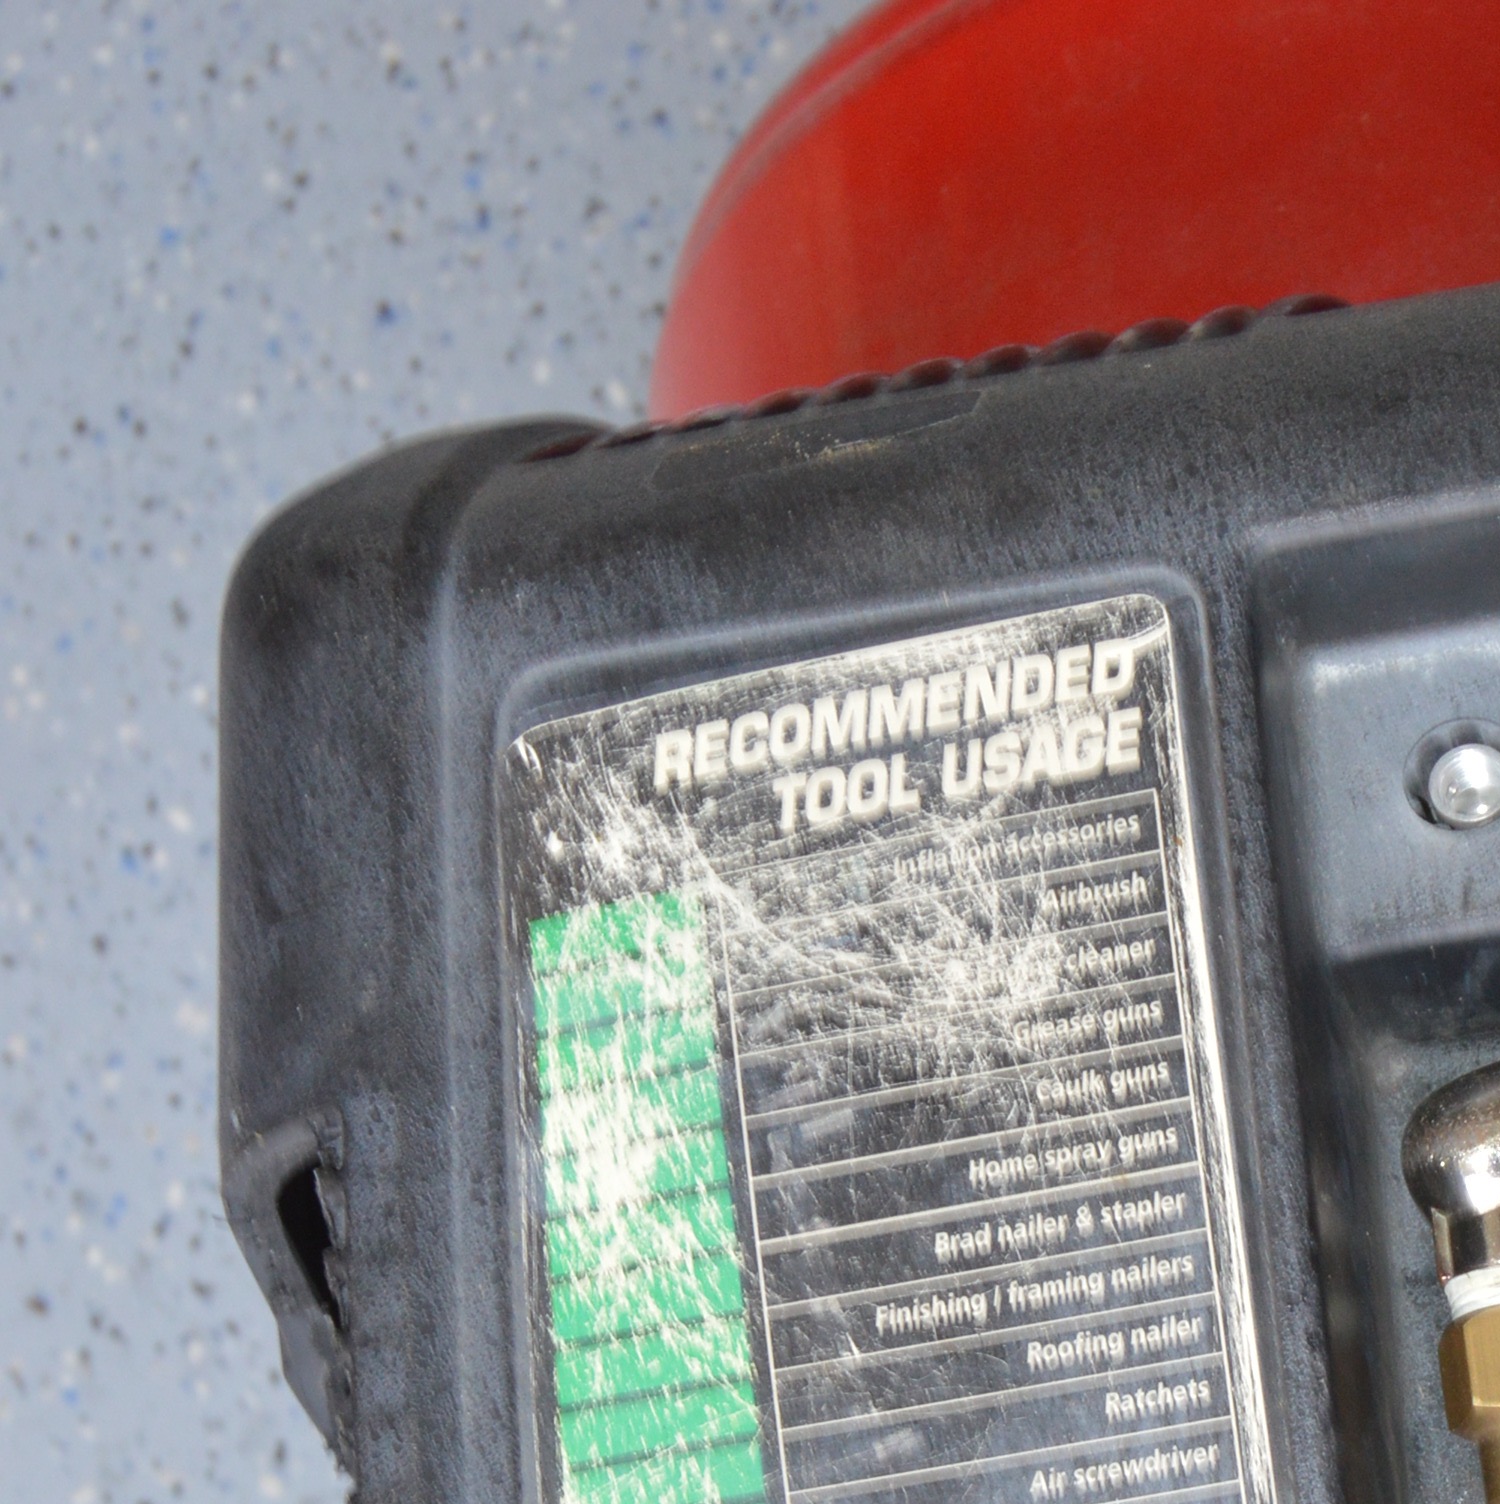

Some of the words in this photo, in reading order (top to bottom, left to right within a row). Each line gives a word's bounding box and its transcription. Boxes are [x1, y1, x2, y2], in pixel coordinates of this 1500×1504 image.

[653, 637, 1135, 796] RECOMMENDED
[772, 754, 922, 834] TOOL
[940, 706, 1143, 798] USAGE
[1042, 871, 1148, 912] Airbrush
[1066, 938, 1157, 977] cleaner
[1012, 1008, 1097, 1046] Grease
[1102, 1000, 1162, 1034] guns
[1036, 1068, 1105, 1104] Caulk
[1109, 1061, 1170, 1097] guns
[968, 1154, 1037, 1184] Home
[1044, 1138, 1112, 1173] spray
[1118, 1126, 1178, 1161] guns
[934, 1223, 992, 1257] Brad
[997, 1211, 1069, 1246] nailer
[1101, 1189, 1187, 1230] stapler
[875, 1291, 988, 1332] Finishing
[1007, 1269, 1105, 1308] framing
[1111, 1253, 1195, 1289] nailers
[1026, 1330, 1125, 1368] Roofing
[1130, 1314, 1202, 1348] nailer
[1104, 1376, 1210, 1418] Ratchets
[1029, 1468, 1068, 1498] Air
[1073, 1442, 1220, 1489] screwdriver
